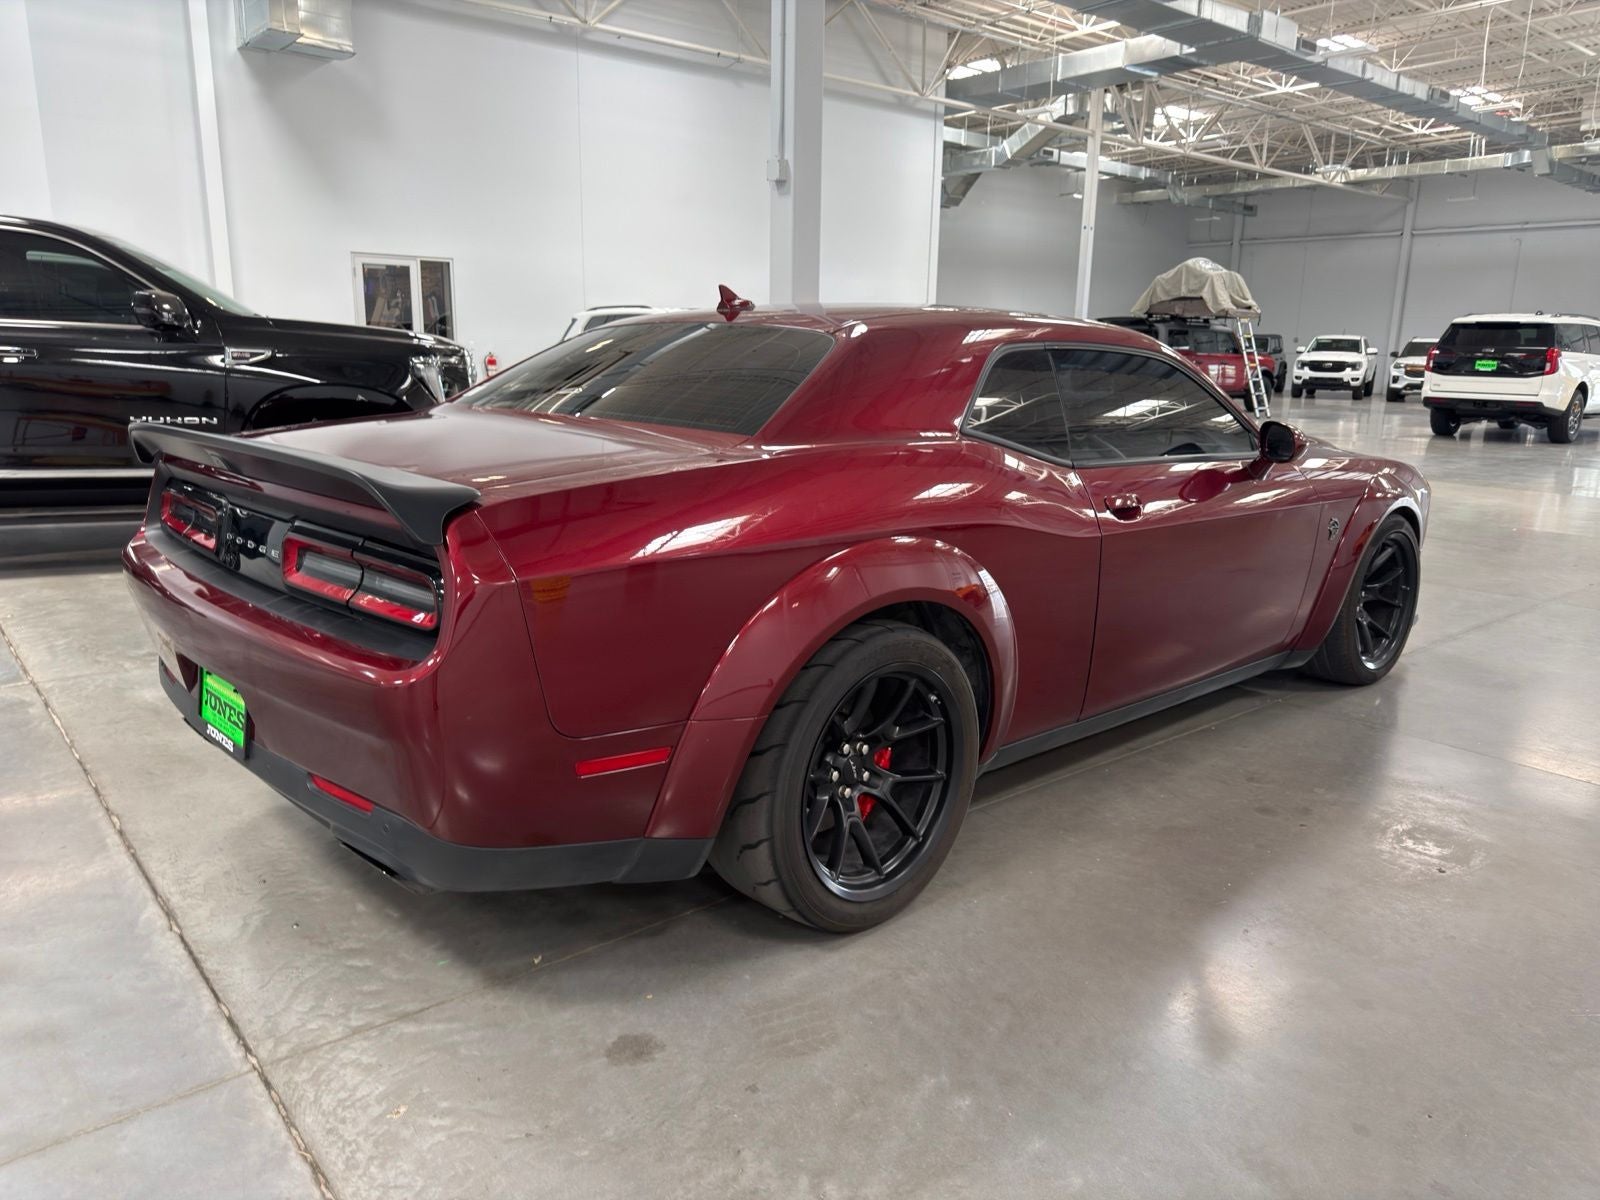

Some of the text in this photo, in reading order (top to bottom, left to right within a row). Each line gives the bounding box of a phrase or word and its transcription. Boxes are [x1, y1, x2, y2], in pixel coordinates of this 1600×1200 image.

[129, 416, 218, 424] YUKON
[226, 532, 280, 559] DODGE
[205, 687, 245, 731] JONES
[206, 723, 234, 753] JONES
